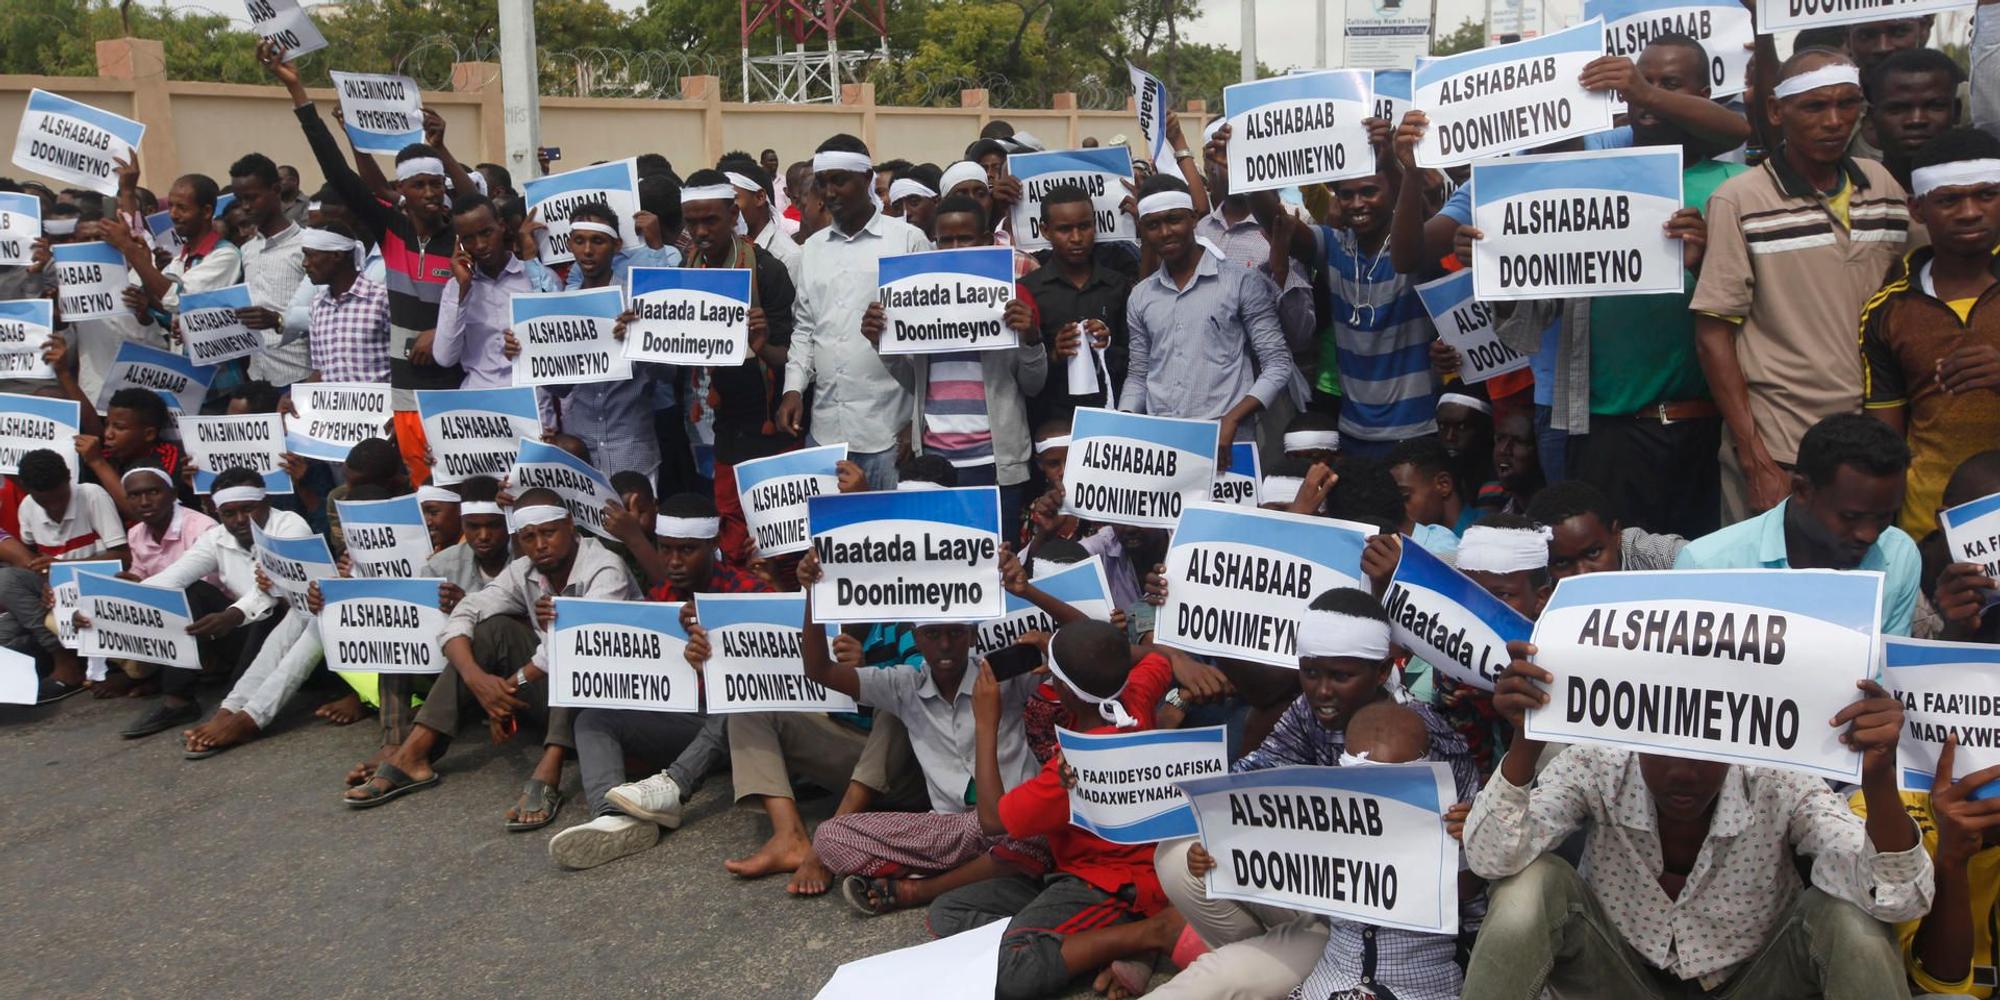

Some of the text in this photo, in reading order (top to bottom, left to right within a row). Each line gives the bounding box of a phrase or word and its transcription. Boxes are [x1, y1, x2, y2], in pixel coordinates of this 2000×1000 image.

[344, 79, 405, 101] DOONIMEYNO
[1439, 57, 1556, 106] ALSHABAAB
[39, 115, 111, 151] ALSHABAAB
[356, 110, 410, 130] ALSHABAAB
[1246, 102, 1335, 140] ALSHABAAB
[1439, 97, 1571, 156] DOONIMEYNO
[30, 140, 110, 178] DOONIMEYNO
[1246, 143, 1345, 182] DOONIMEYNO
[1502, 195, 1630, 235] ALSHABAAB
[1500, 249, 1642, 287] DOONIMEYNO
[879, 282, 1009, 309] Maatada Laaye
[633, 299, 745, 327] Maatada Laaye
[193, 332, 258, 359] DOONIMEYNO
[528, 318, 598, 345] ALSHABAAB
[642, 331, 734, 357] Doonimeyno
[895, 319, 1001, 343] Doonimeyno
[123, 364, 187, 394] ALSHABAAB
[531, 351, 610, 378] DOONIMEYNO
[312, 390, 384, 413] DOONIMEYNO
[198, 421, 270, 443] DOONIMEYNO
[309, 420, 378, 441] ALSHABAAB
[441, 416, 513, 440] ALSHABAAB
[209, 452, 270, 472] ALSHABAAB
[1082, 441, 1177, 477] ALSHABAAB
[519, 467, 595, 496] ALSHABAAB
[1212, 480, 1253, 503] aaye
[1074, 482, 1181, 518] DOONIMEYNO
[815, 532, 994, 567] Maatada Laaye
[1963, 540, 1987, 559] KA
[1185, 548, 1312, 600] ALSHABAAB
[837, 576, 983, 612] Doonimeyno
[94, 598, 164, 629] ALSHABAAB
[341, 604, 420, 629] ALSHABAAB
[1384, 583, 1474, 670] Maatada
[98, 629, 177, 660] DOONIMEYNO
[575, 630, 661, 659] ALSHABAAB
[1178, 602, 1301, 657] DOONIMEYN
[1578, 608, 1787, 666] ALSHABAAB
[339, 641, 430, 666] DOONIMEYNO
[572, 671, 671, 702] DOONIMEYNO
[725, 674, 826, 702] DOONIMEYNO
[1566, 675, 1799, 751] DOONIMEYNO
[1083, 766, 1161, 784] FAA'IIDEYSO
[1166, 758, 1222, 778] CAFISKA
[1229, 793, 1383, 837] ALSHABAAB
[1232, 848, 1398, 911] DOONIMEYNO
